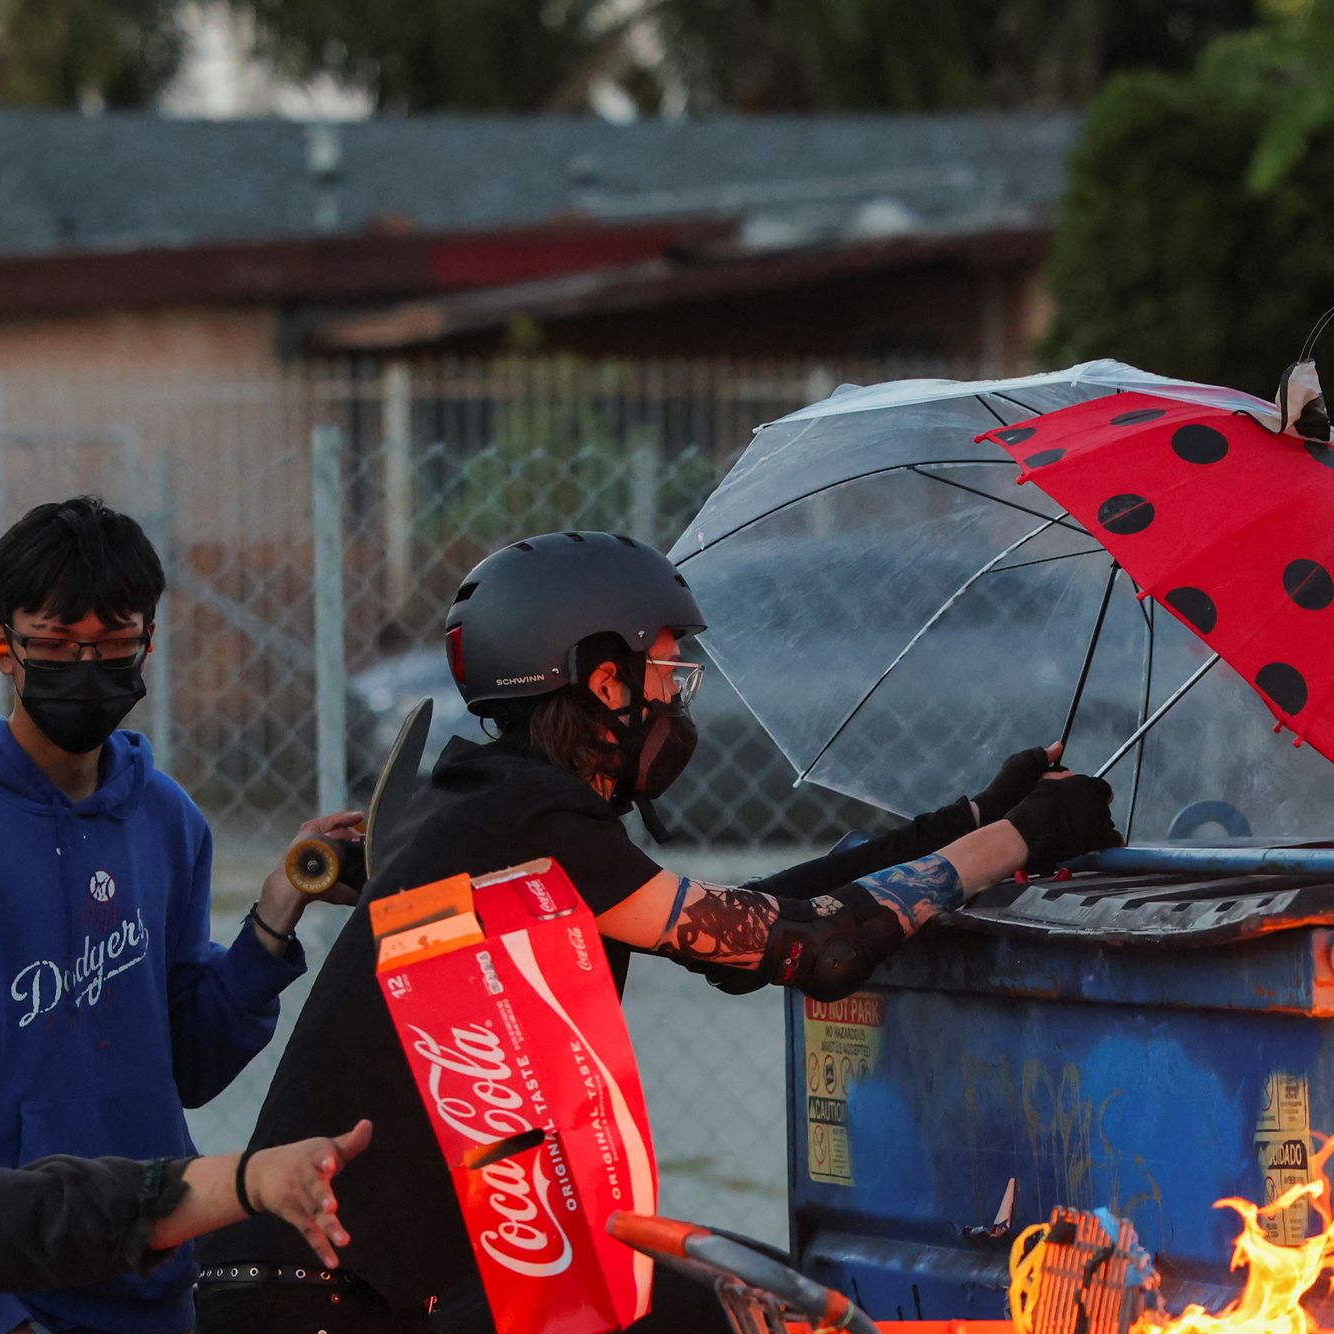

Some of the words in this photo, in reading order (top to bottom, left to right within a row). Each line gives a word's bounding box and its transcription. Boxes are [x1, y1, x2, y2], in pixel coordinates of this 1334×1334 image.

[495, 673, 545, 686] SCHWINN
[11, 907, 150, 1028] Dodgers
[388, 974, 407, 1000] 12
[850, 997, 880, 1026] PARK
[516, 1055, 548, 1115] TASTE
[570, 1041, 600, 1101] TASTE
[545, 1118, 578, 1212] ORIGINAL
[589, 1105, 622, 1200] ORIGINAL
